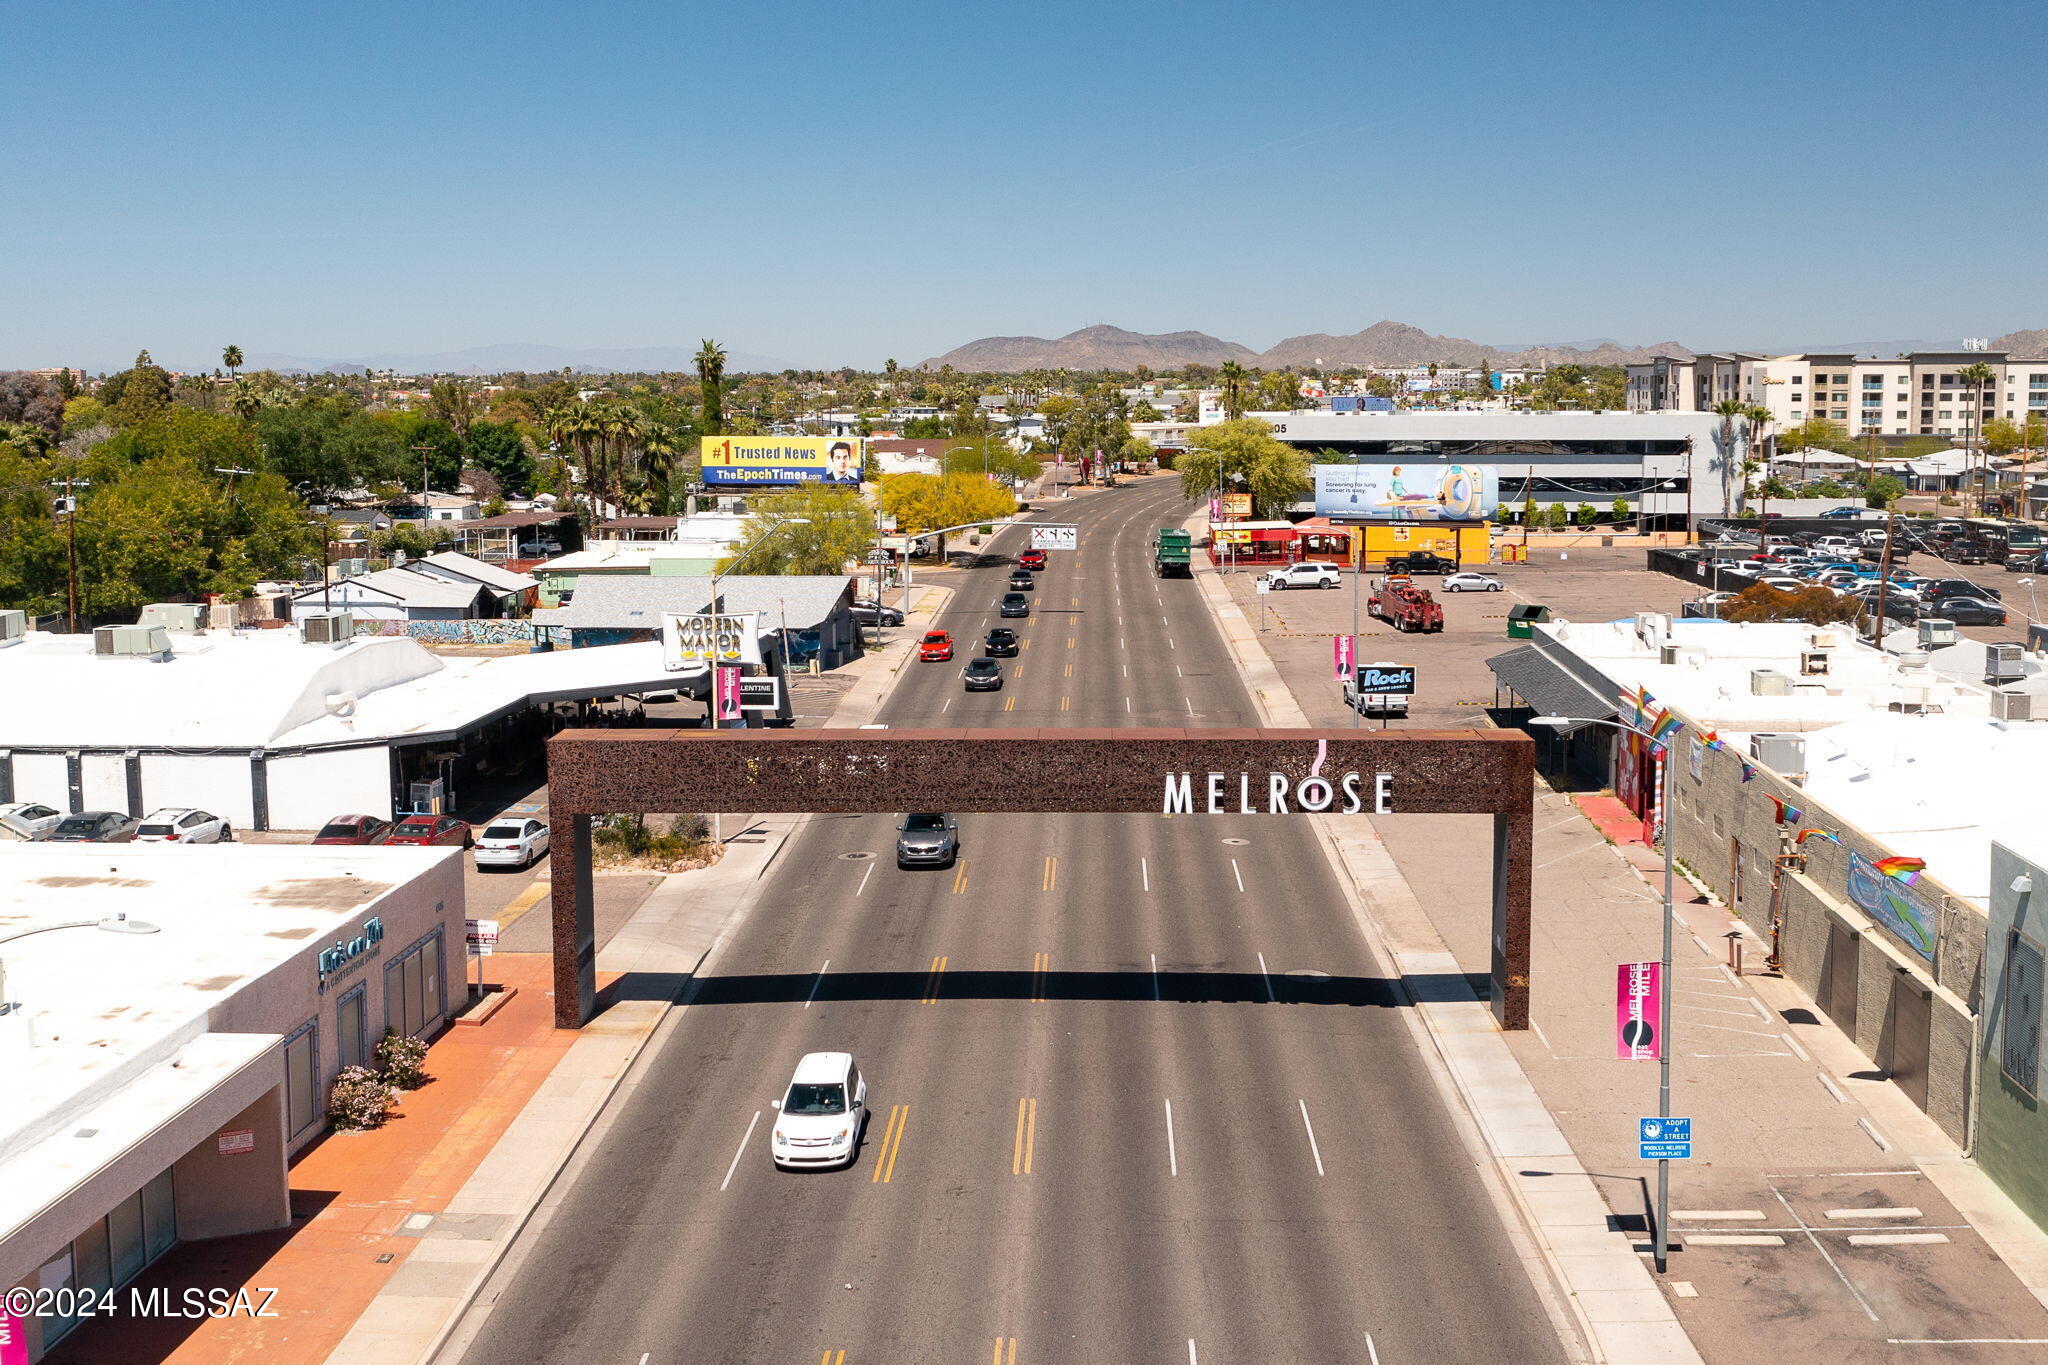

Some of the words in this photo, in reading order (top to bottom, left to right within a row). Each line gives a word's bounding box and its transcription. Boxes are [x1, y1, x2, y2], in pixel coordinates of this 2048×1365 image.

[713, 440, 730, 464] #1
[734, 446, 780, 459] Trusted
[784, 448, 816, 459] News
[675, 617, 744, 635] MODERN
[1364, 669, 1412, 687] Rock
[1163, 771, 1393, 815] MELROSE
[1629, 963, 1639, 1021] MELROSE
[1641, 962, 1651, 996] MILE
